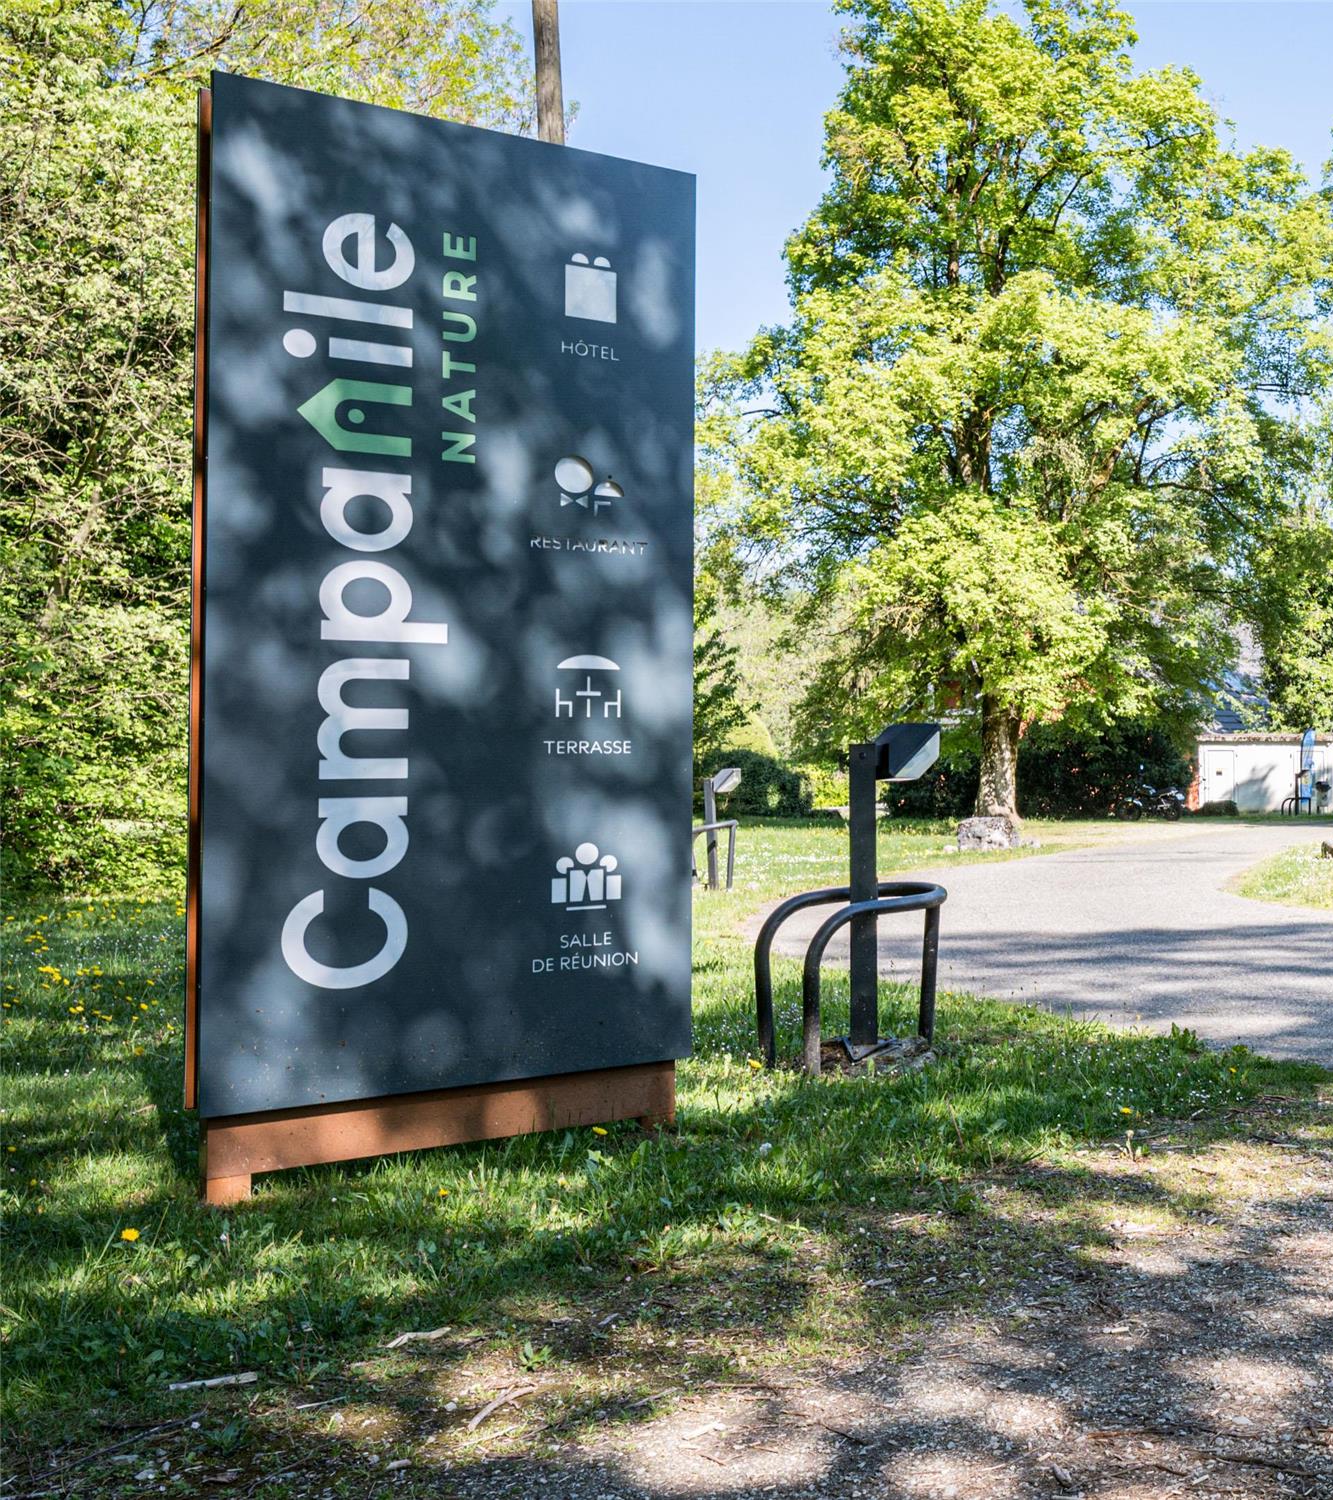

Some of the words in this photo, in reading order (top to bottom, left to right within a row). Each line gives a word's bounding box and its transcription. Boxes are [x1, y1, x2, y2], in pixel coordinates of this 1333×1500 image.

[441, 231, 478, 465] NATURE
[561, 339, 620, 361] HÔTEL
[530, 535, 648, 556] RESTAURANT
[281, 212, 449, 990] Campanile
[543, 740, 632, 755] TERRASSE
[560, 931, 612, 949] SALLE
[532, 957, 555, 973] DE
[560, 951, 639, 971] RÉUNION
